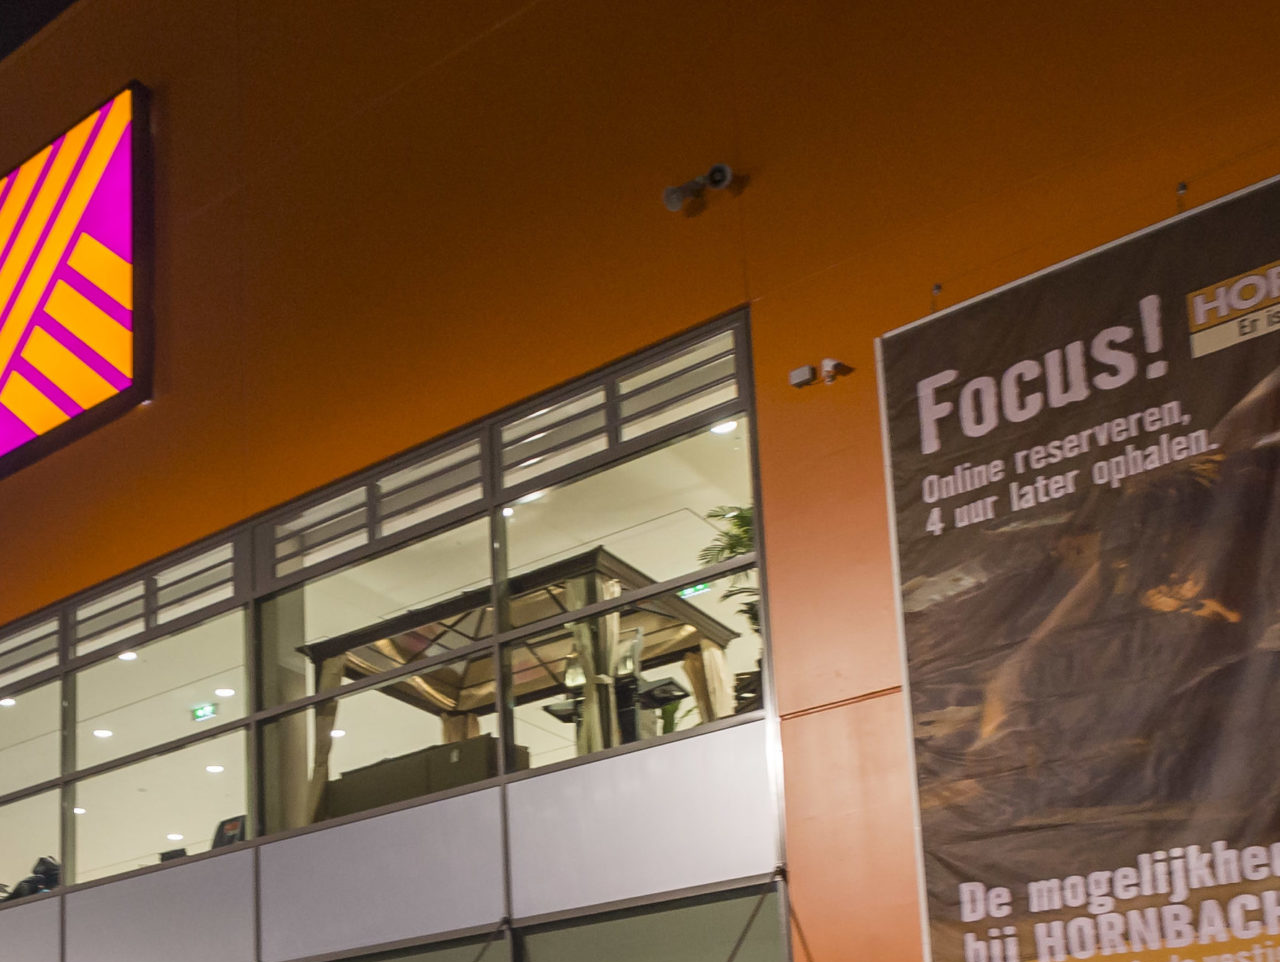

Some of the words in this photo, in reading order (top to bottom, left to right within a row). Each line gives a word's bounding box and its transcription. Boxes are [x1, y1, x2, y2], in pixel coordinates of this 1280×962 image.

[922, 458, 1006, 504] Online
[1014, 400, 1191, 474] reserveren,
[925, 506, 945, 536] 4
[1009, 469, 1081, 511] later
[1092, 429, 1220, 488] ophalen.
[959, 881, 1012, 922] De
